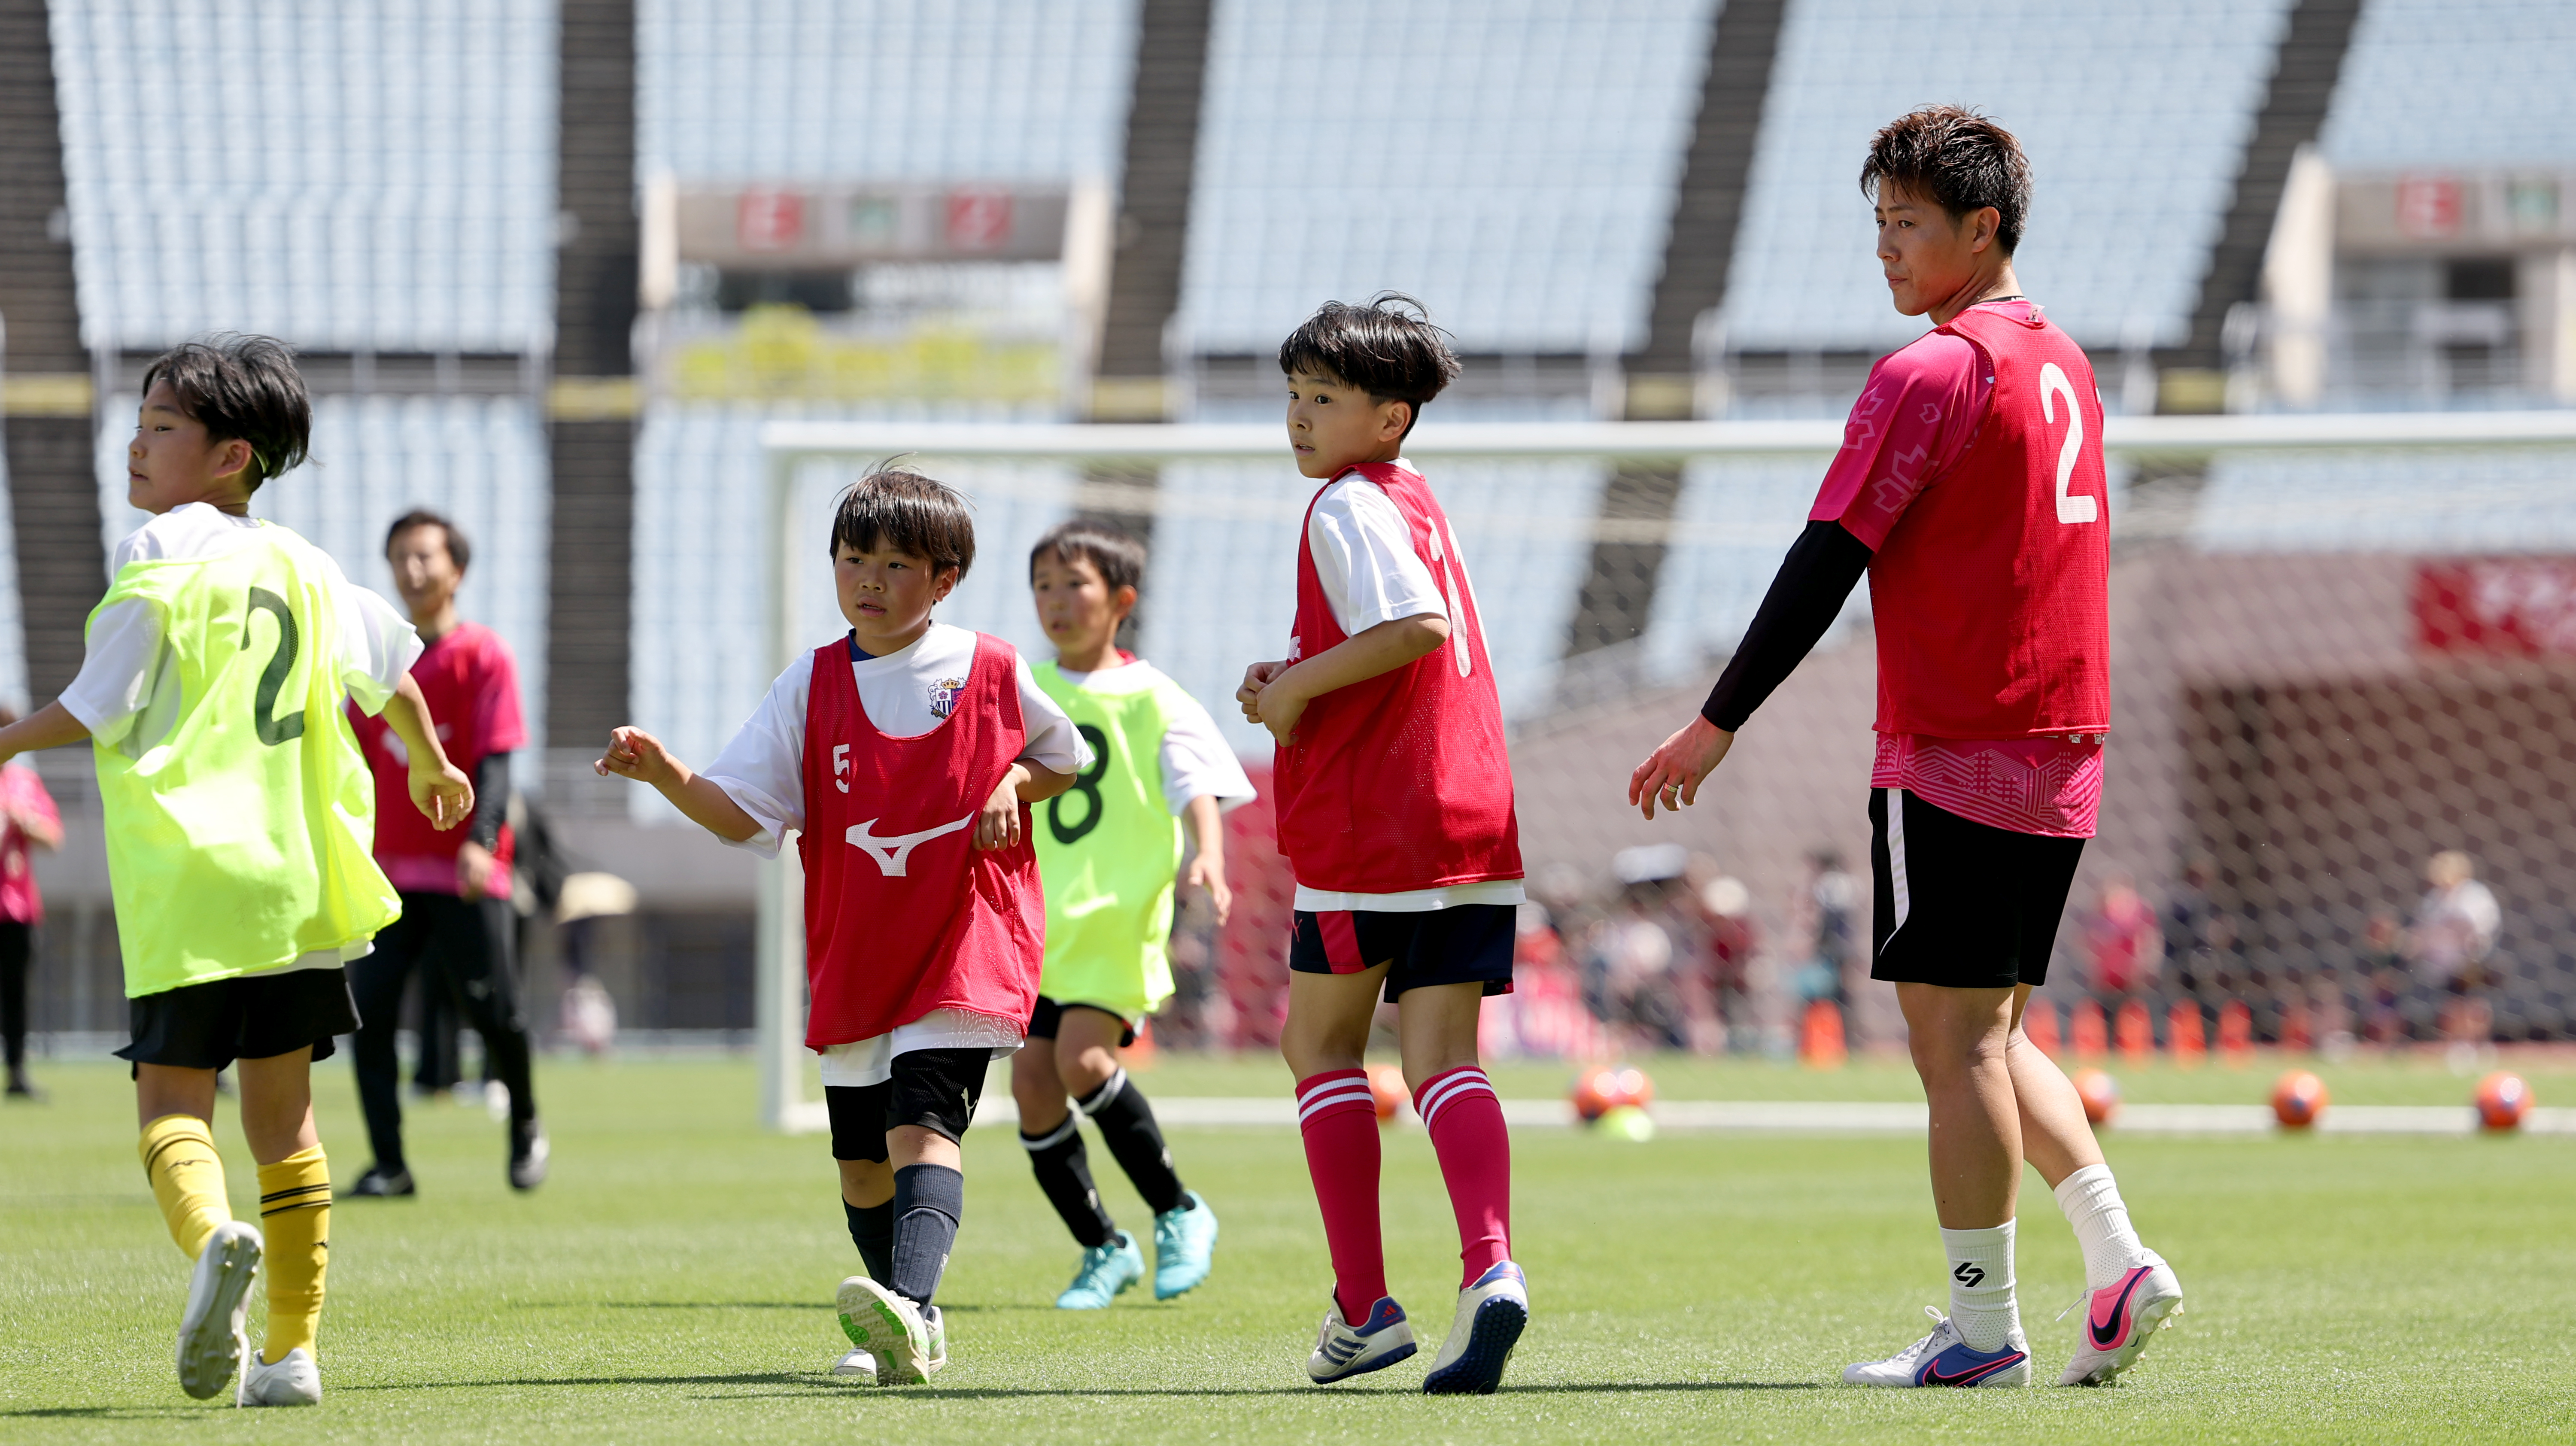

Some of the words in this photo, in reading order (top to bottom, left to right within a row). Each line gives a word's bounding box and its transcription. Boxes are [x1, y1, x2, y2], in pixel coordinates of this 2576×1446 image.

[2040, 362, 2098, 524] 2
[240, 586, 305, 746] 2
[833, 743, 851, 793] 5
[1049, 724, 1109, 845] 8
